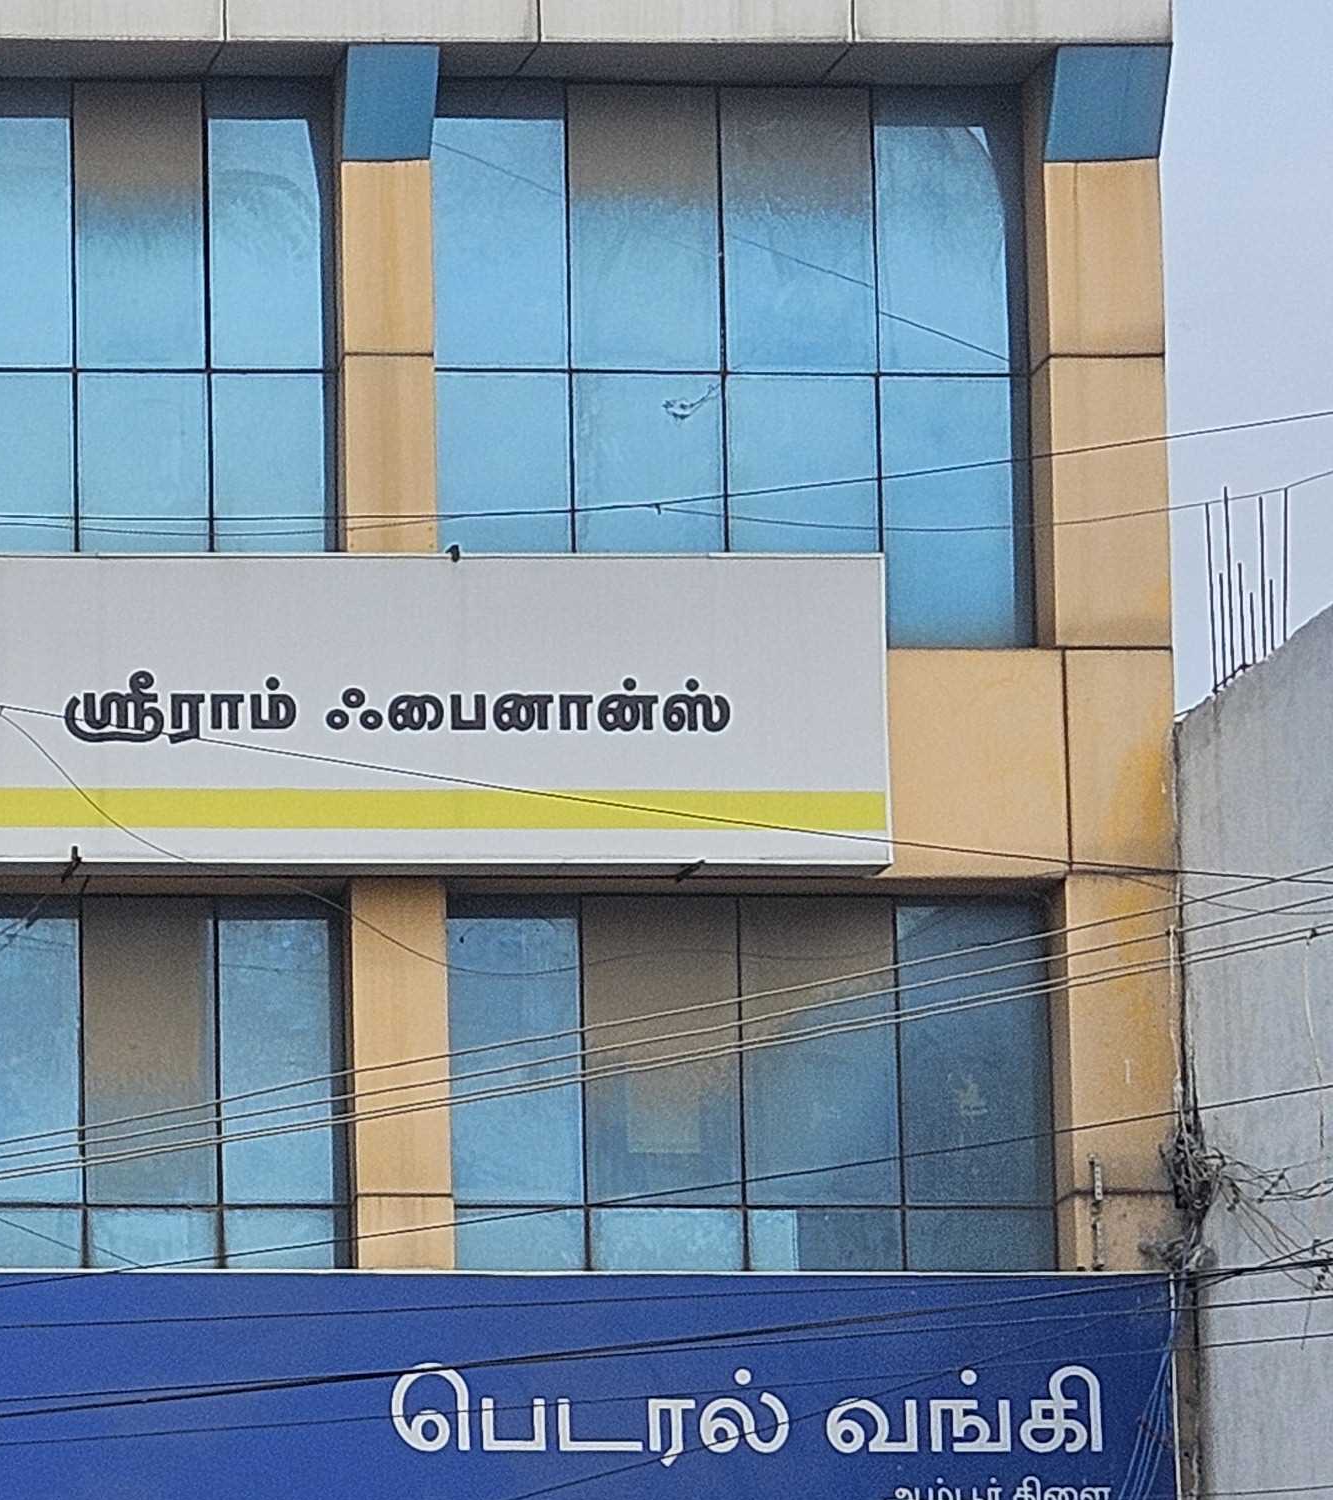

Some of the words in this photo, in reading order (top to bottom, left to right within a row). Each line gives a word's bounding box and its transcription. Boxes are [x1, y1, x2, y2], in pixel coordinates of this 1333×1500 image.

[325, 678, 731, 733] ஃபைனான்ஸ்
[391, 1363, 790, 1467] பெடரல்
[827, 1365, 1103, 1455] வங்கி
